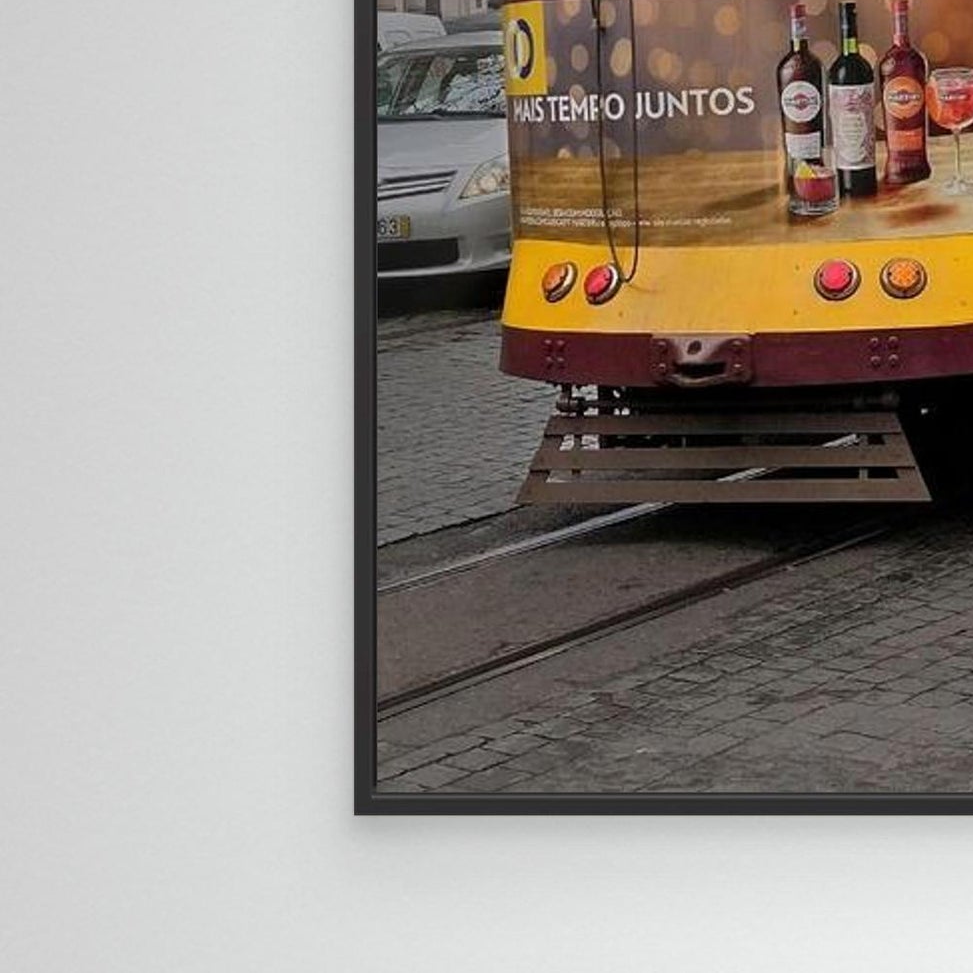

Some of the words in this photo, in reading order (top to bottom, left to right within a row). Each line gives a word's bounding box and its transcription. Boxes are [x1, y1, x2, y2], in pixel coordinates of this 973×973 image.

[513, 96, 545, 123] MAIS
[546, 93, 625, 123] TEMPO
[635, 87, 755, 120] JUNTOS
